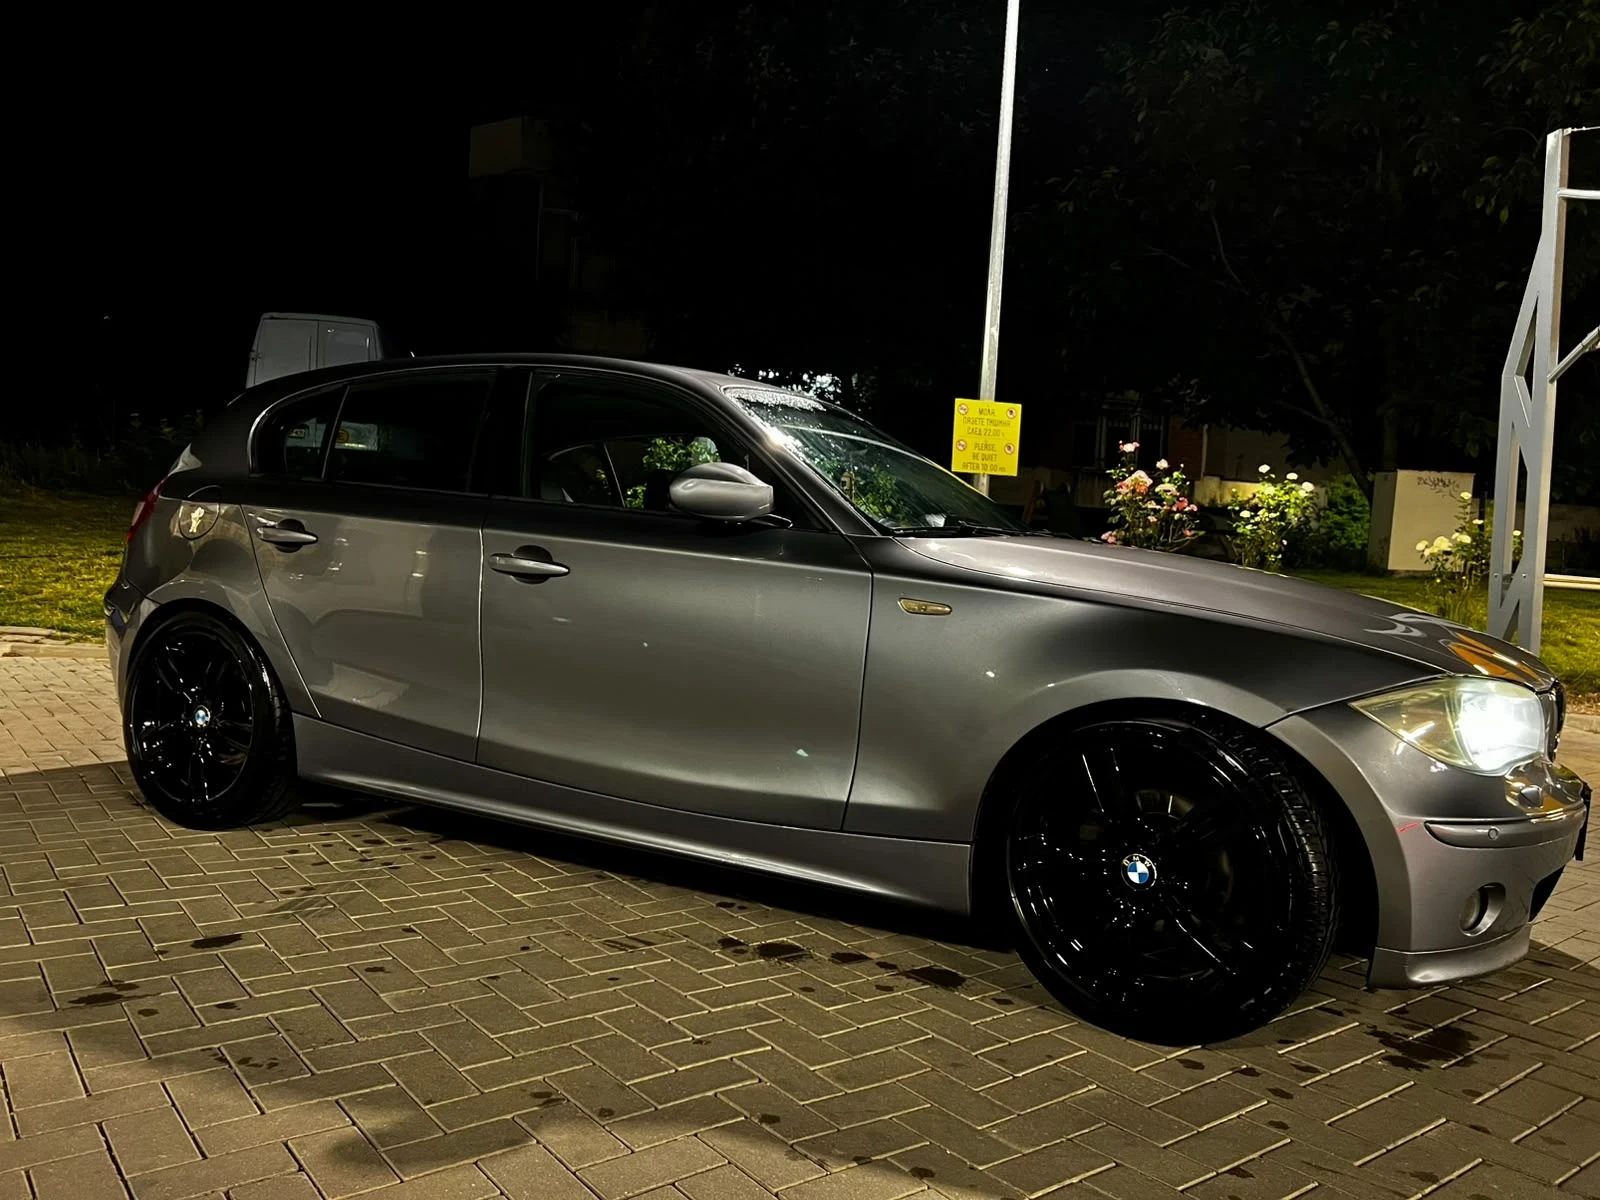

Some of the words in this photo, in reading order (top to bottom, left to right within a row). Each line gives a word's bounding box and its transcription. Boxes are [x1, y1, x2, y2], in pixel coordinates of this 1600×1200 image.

[972, 452, 980, 461] BE
[981, 453, 998, 462] QUIET
[962, 462, 980, 471] AFTER
